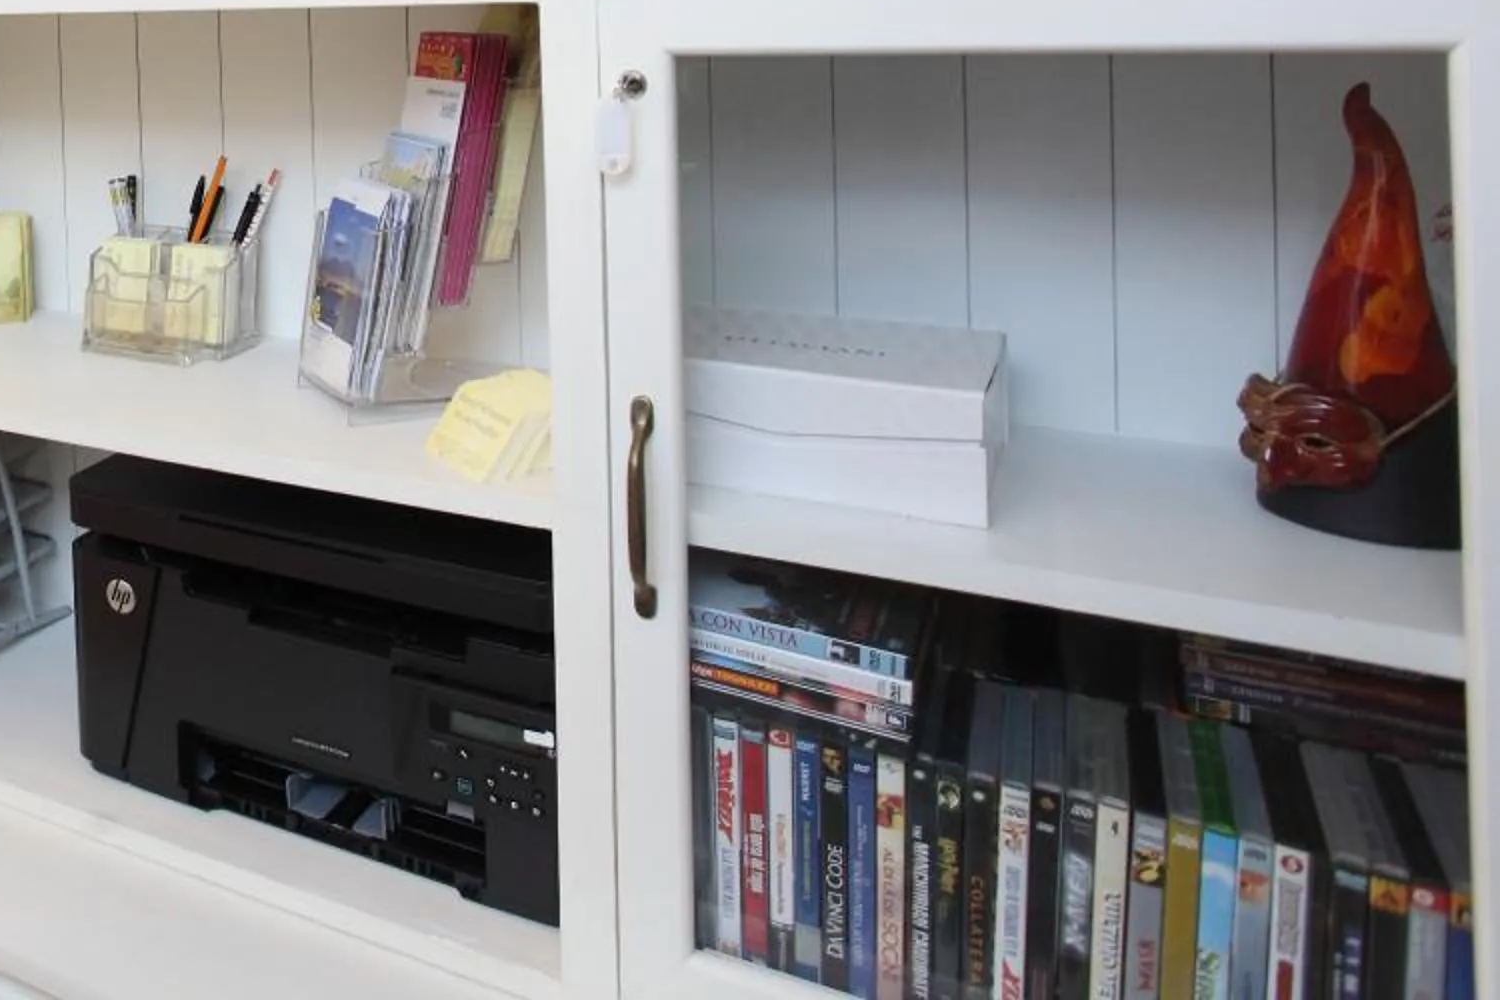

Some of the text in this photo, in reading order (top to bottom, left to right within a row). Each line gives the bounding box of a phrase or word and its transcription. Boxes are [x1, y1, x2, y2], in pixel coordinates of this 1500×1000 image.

[108, 577, 133, 613] hp
[701, 611, 799, 649] CON VISTA
[826, 843, 844, 959] DA VINCI CODE
[1065, 852, 1088, 953] X-MEN
